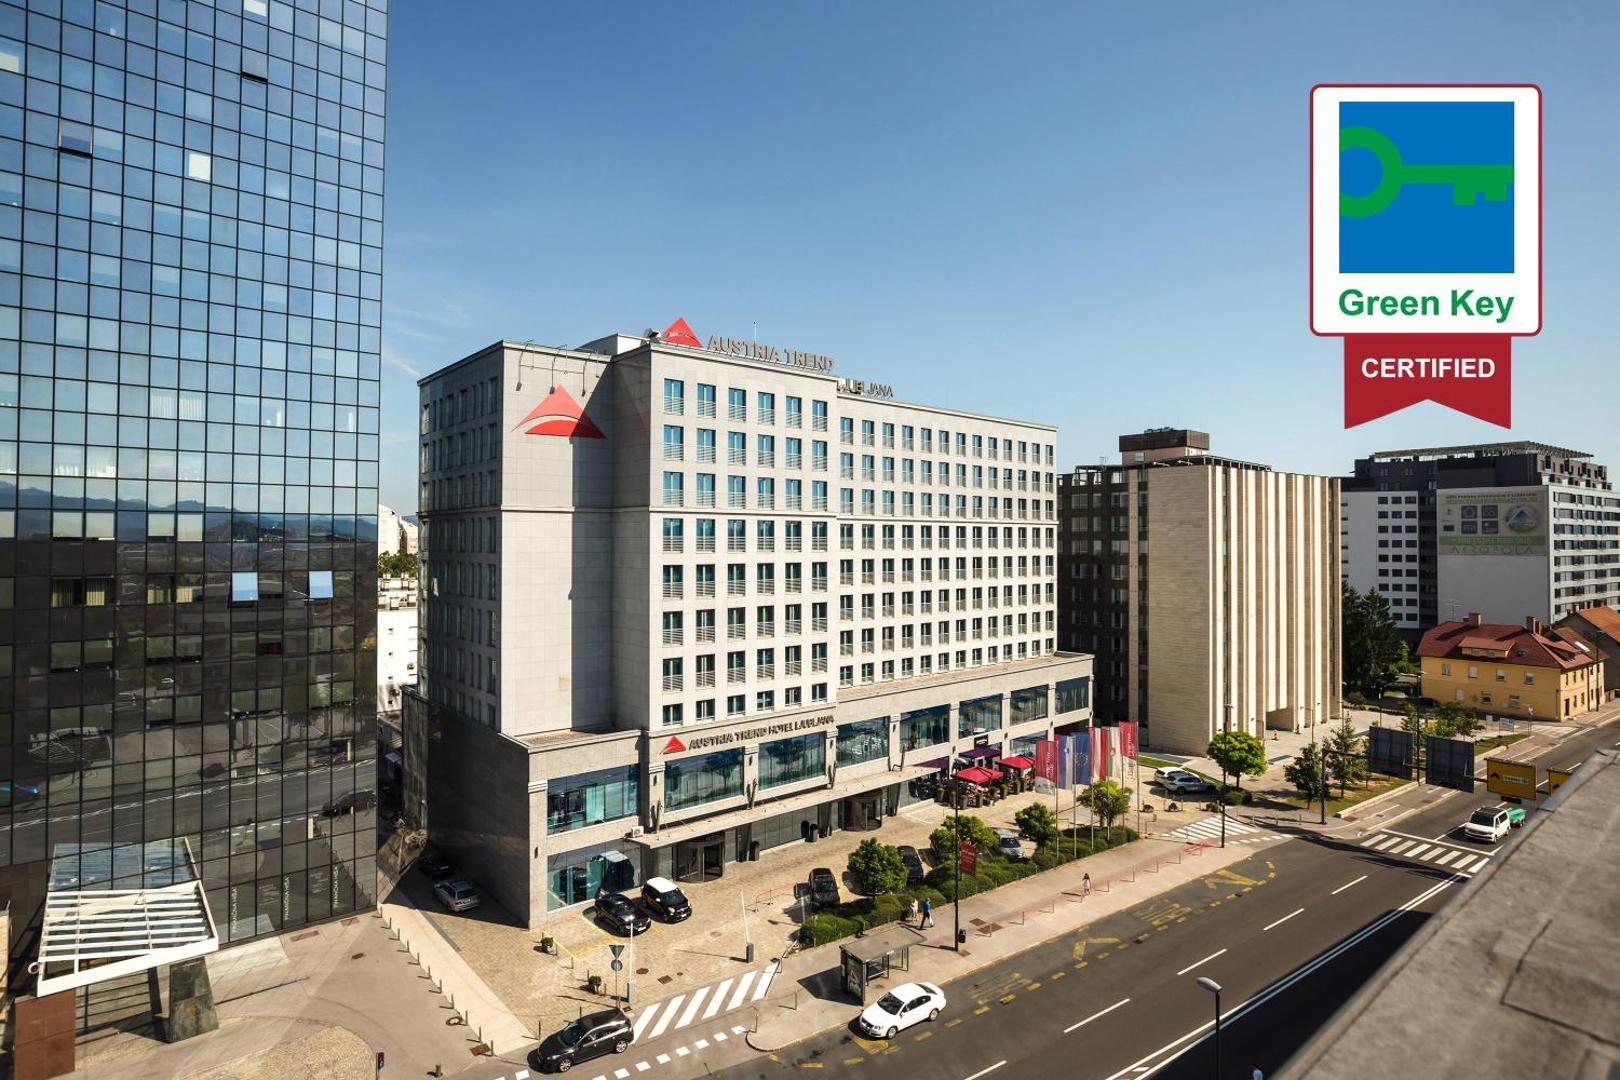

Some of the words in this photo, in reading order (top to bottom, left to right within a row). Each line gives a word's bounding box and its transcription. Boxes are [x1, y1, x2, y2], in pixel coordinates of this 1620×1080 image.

[707, 335, 780, 361] AUSTRIA
[784, 348, 834, 371] TREND
[689, 732, 733, 750] AUSTRIA
[734, 727, 768, 741] TREND
[768, 722, 794, 734] HOTEL
